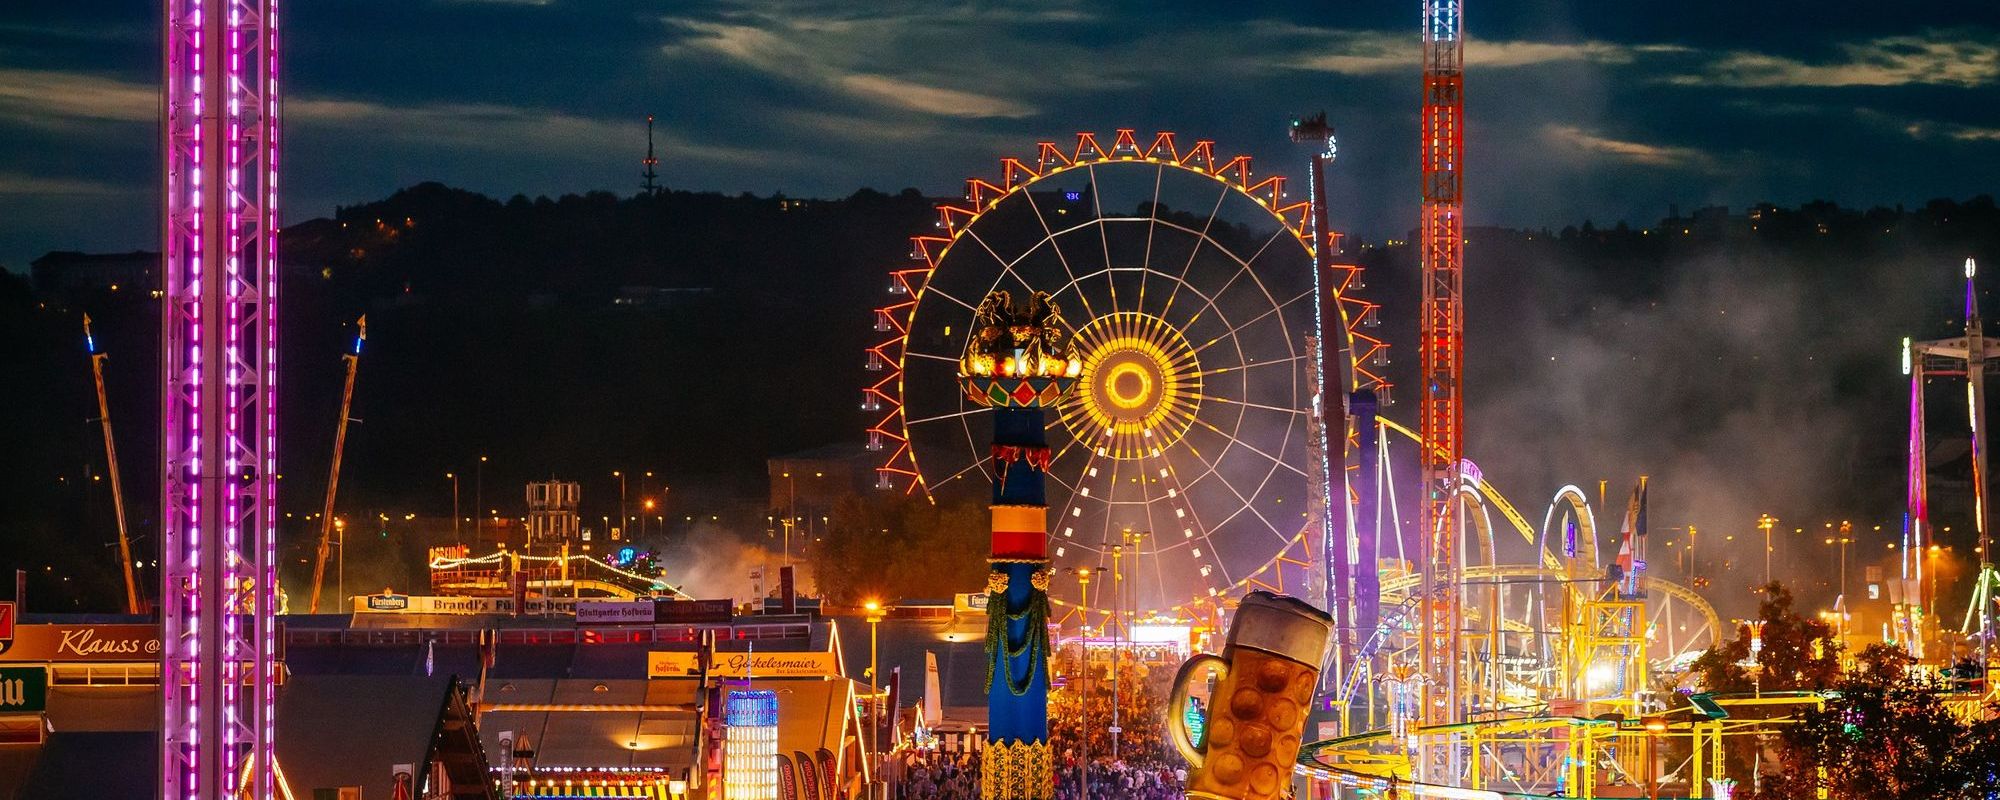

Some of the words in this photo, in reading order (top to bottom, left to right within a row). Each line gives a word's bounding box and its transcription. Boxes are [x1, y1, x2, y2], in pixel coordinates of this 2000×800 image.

[433, 599, 488, 610] Brandl's
[578, 608, 620, 618] Stuttgarter
[621, 607, 652, 617] Hofbräu
[57, 629, 140, 656] Klauss
